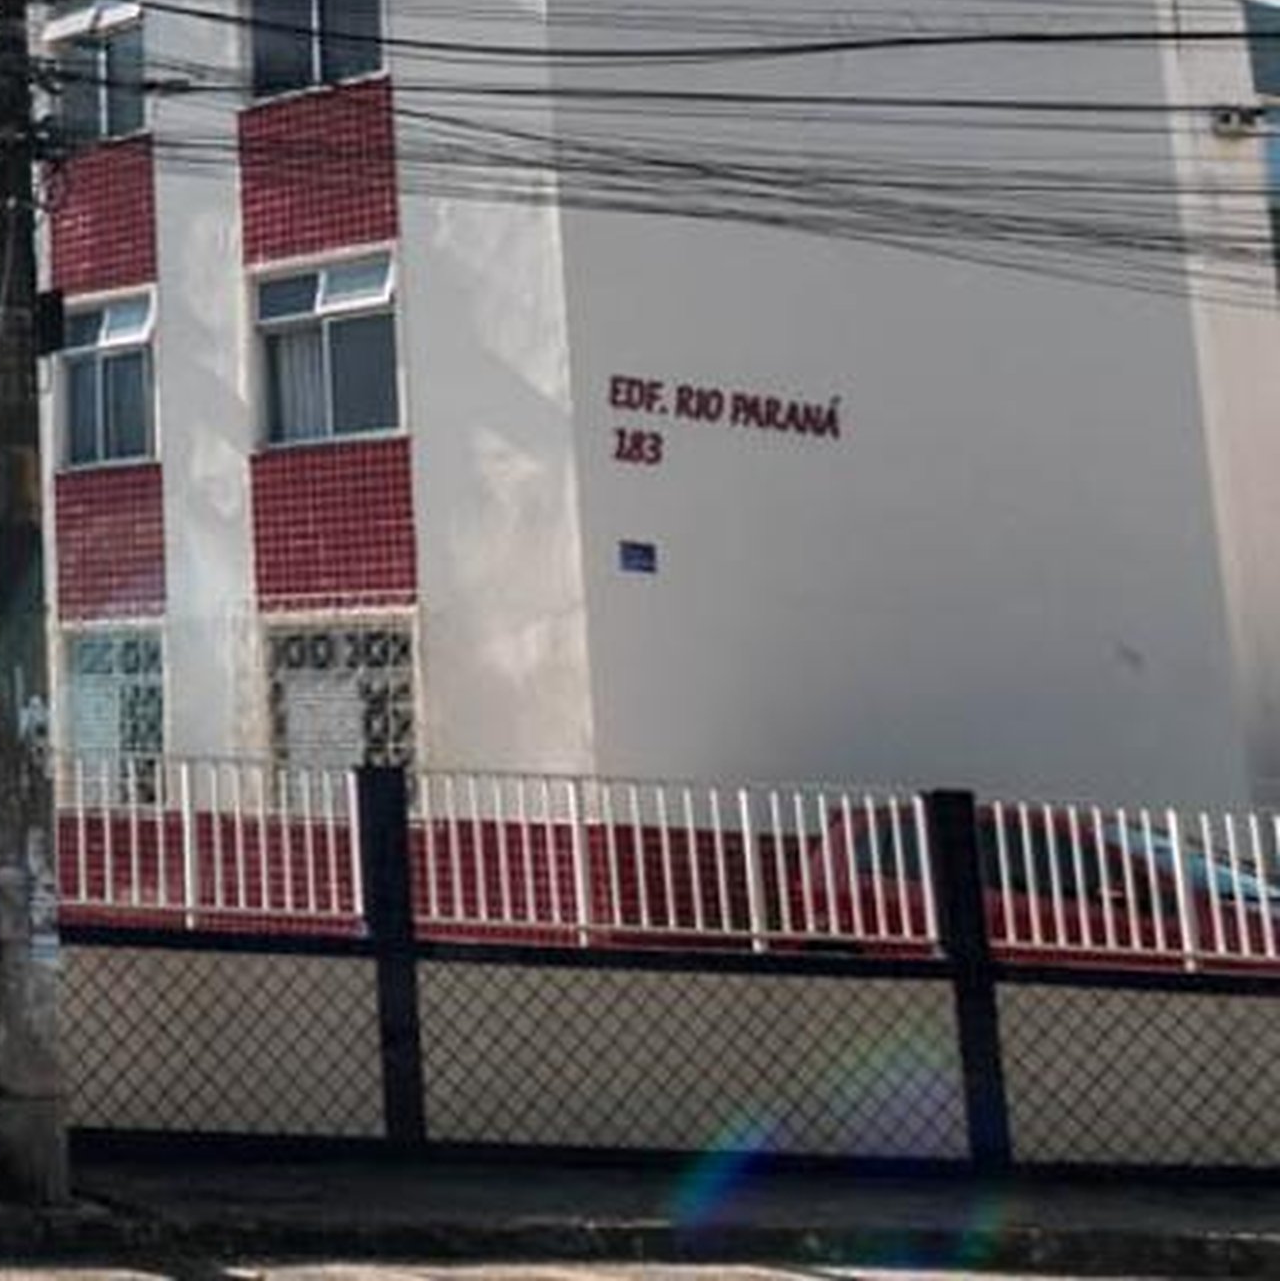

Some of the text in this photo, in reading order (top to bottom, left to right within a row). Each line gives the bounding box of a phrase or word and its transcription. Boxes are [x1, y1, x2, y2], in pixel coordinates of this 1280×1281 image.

[609, 375, 841, 438] EDF. RIO PARANÁ
[614, 428, 663, 465] 183
